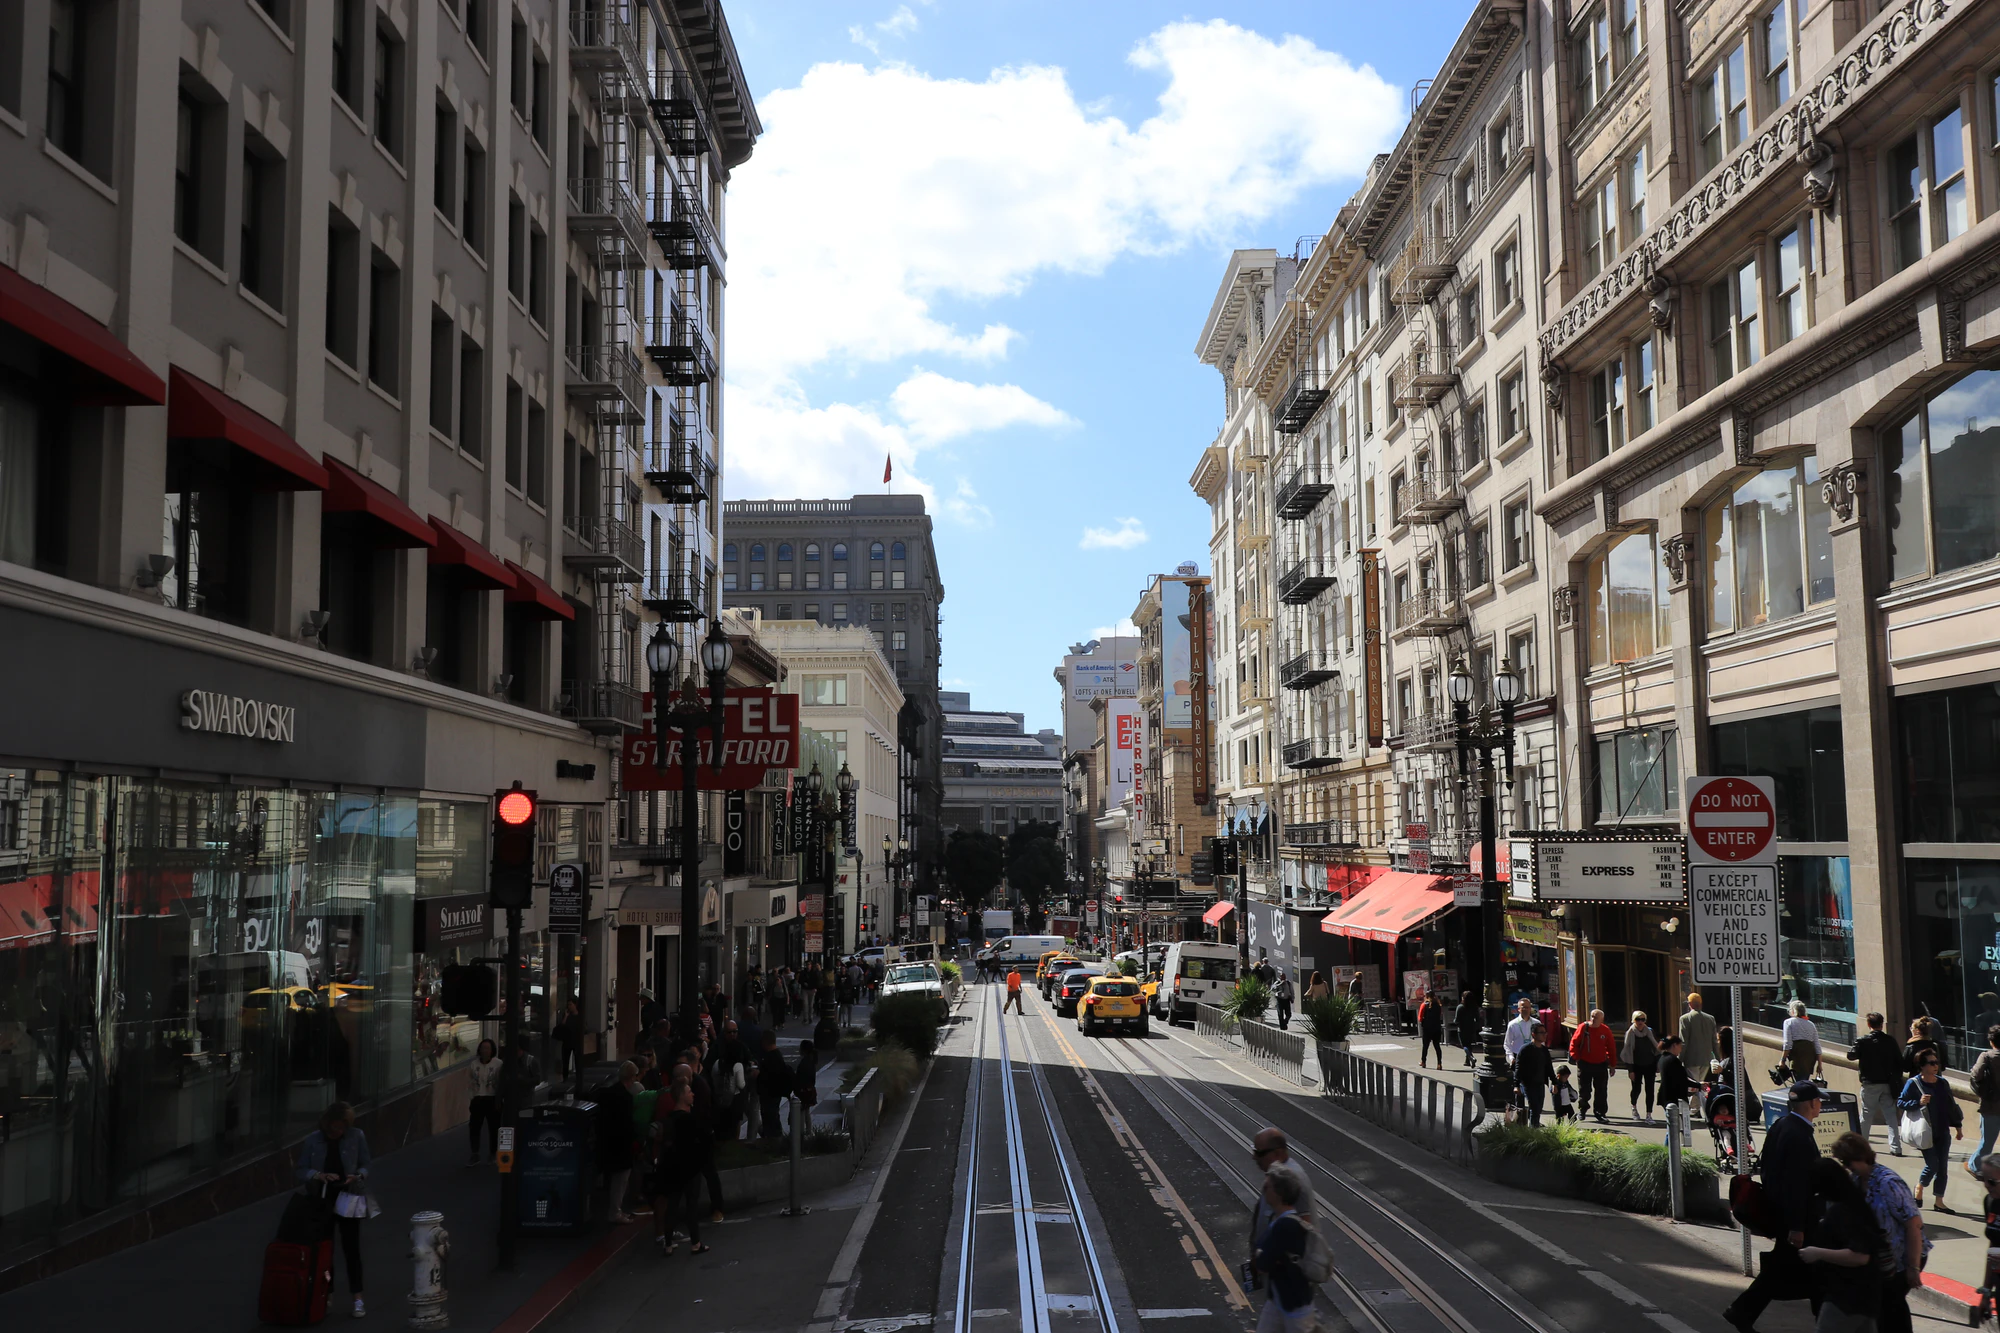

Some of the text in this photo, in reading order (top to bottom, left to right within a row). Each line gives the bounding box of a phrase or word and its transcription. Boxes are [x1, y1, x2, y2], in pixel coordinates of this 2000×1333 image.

[1188, 591, 1205, 669] VILLA
[1363, 558, 1381, 731] VILLA FLORENCE
[1075, 688, 1092, 696] LOFTS
[1100, 688, 1112, 696] ONE
[1114, 688, 1136, 696] POWELL
[186, 689, 295, 742] SWAROVSKI
[643, 696, 791, 734] TEL
[1189, 671, 1203, 788] FLORENCE
[630, 739, 790, 766] STRTFORD
[1133, 716, 1143, 821] HERBERT
[1701, 794, 1760, 808] DO NOT
[774, 777, 783, 850] CCKTAILS
[794, 781, 802, 848] WINE SHOP
[1708, 832, 1756, 845] ENTER
[1541, 847, 1565, 855] EXPRESS
[1652, 846, 1677, 854] FASHION
[1546, 855, 1562, 863] JEANS
[1550, 863, 1559, 871] FIT
[1582, 866, 1635, 876] EXPRESS
[1660, 872, 1672, 880] AND
[1709, 874, 1758, 887] EXCEPT
[1696, 889, 1773, 902] COMMERCIAL
[1704, 904, 1767, 916] VEHICLES
[626, 911, 648, 923] HOTEL
[1247, 912, 1257, 945] GG
[1270, 909, 1285, 946] UGG
[1722, 918, 1749, 931] AND
[1705, 933, 1768, 946] VEHICLES
[1708, 947, 1765, 961] LOADING
[1699, 962, 1776, 976] ON POWELL
[1813, 1120, 1845, 1128] ARTLETT
[549, 1141, 574, 1149] SQUARE
